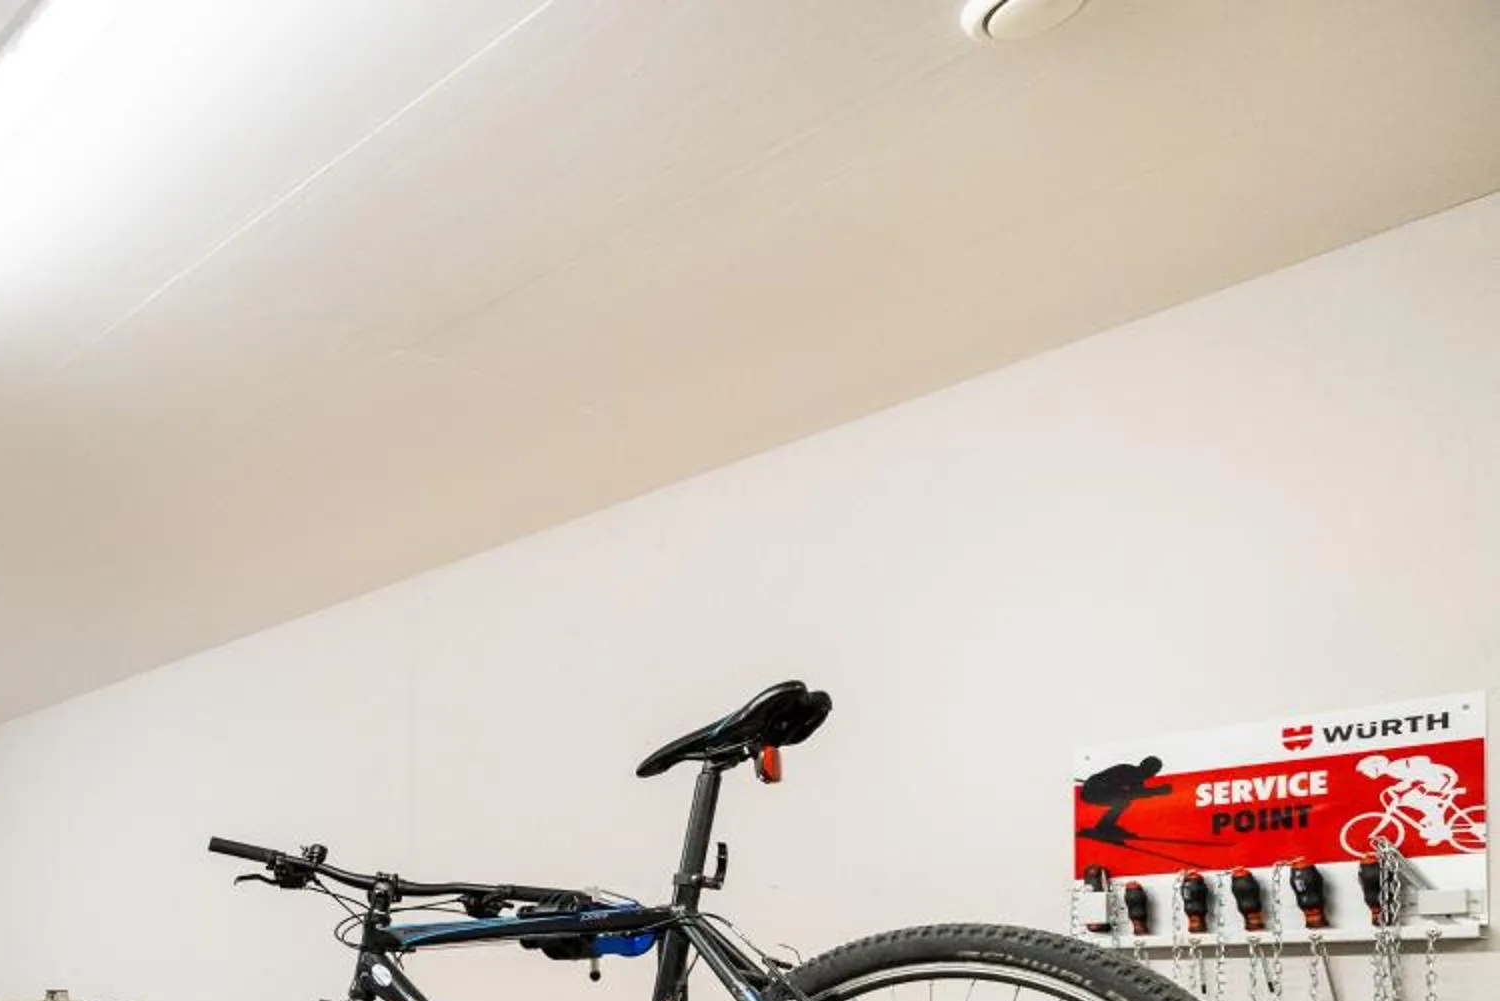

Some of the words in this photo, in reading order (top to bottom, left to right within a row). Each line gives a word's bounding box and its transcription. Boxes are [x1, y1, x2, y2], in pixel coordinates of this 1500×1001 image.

[1322, 711, 1449, 743] WÜRTH
[1195, 770, 1329, 807] SERVICE
[1211, 804, 1312, 836] POINT
